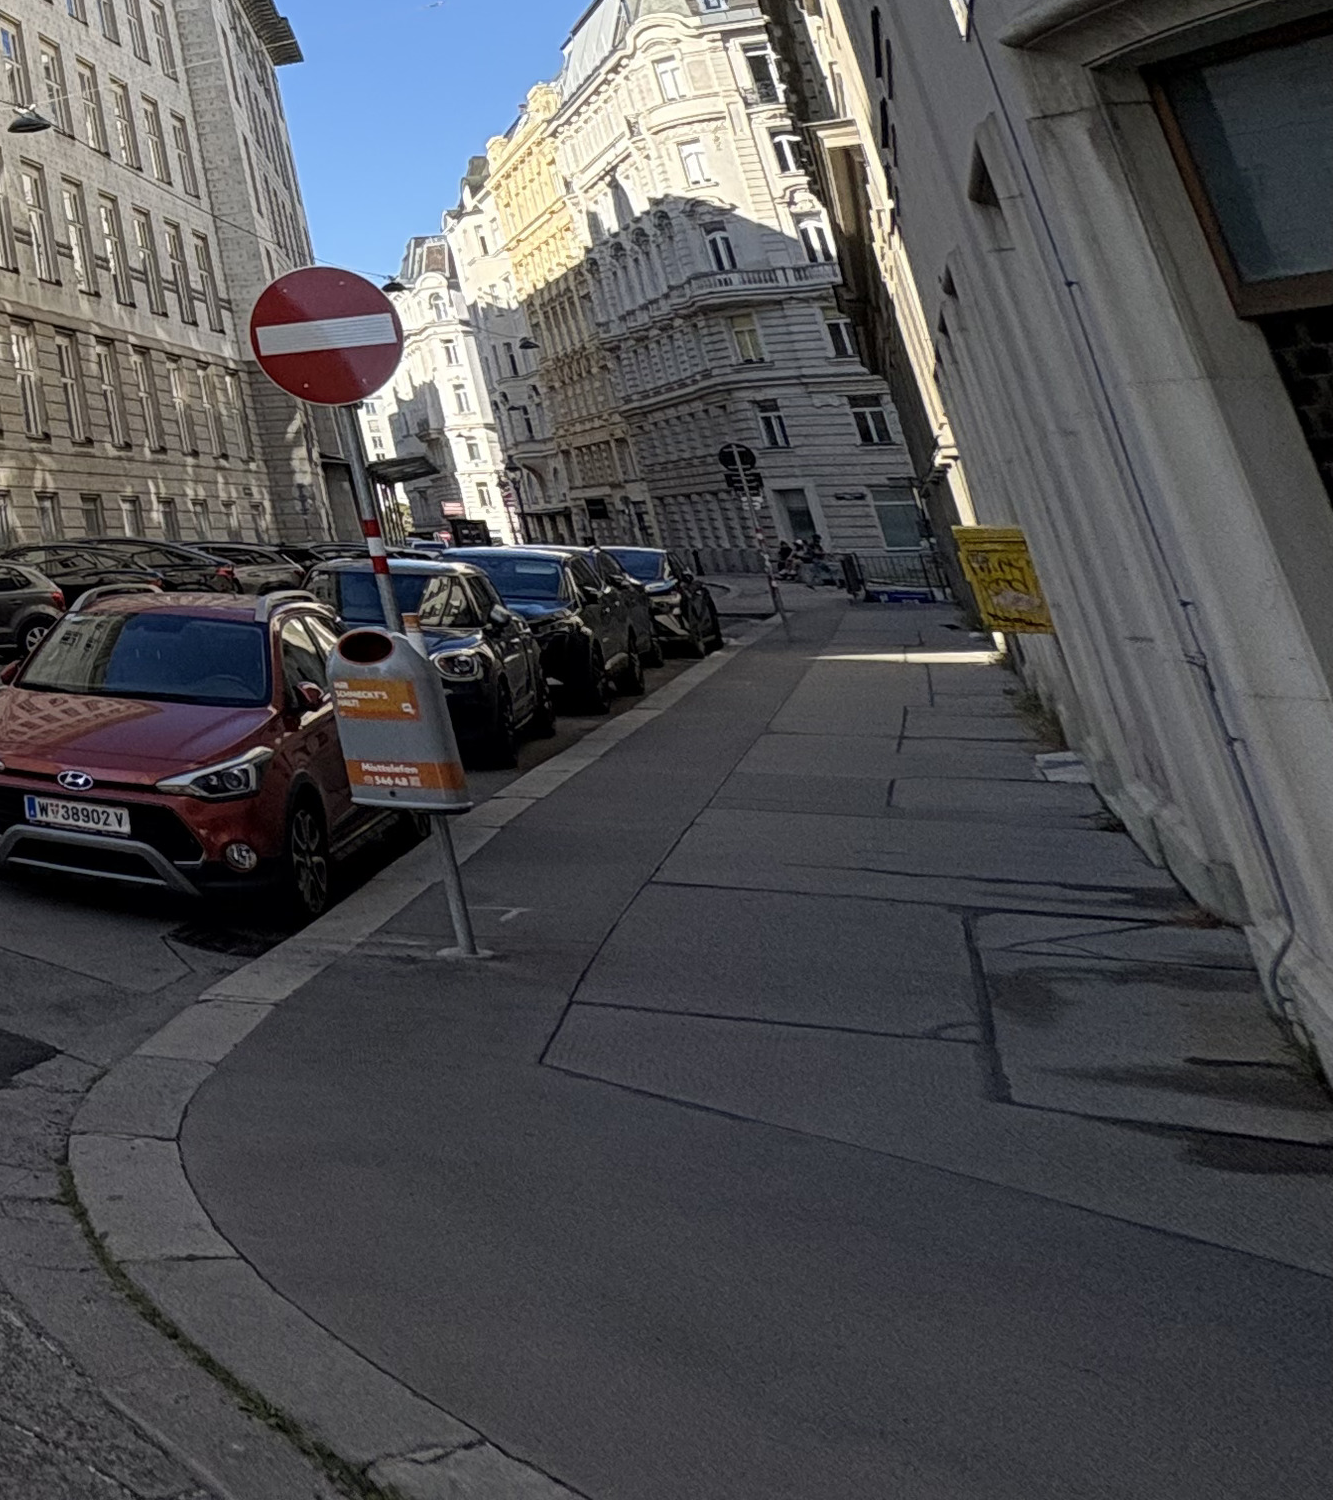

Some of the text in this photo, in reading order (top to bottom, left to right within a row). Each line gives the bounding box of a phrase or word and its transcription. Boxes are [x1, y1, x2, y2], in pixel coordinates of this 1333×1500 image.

[361, 762, 419, 774] Misttelefon
[38, 801, 124, 828] W 38902 V
